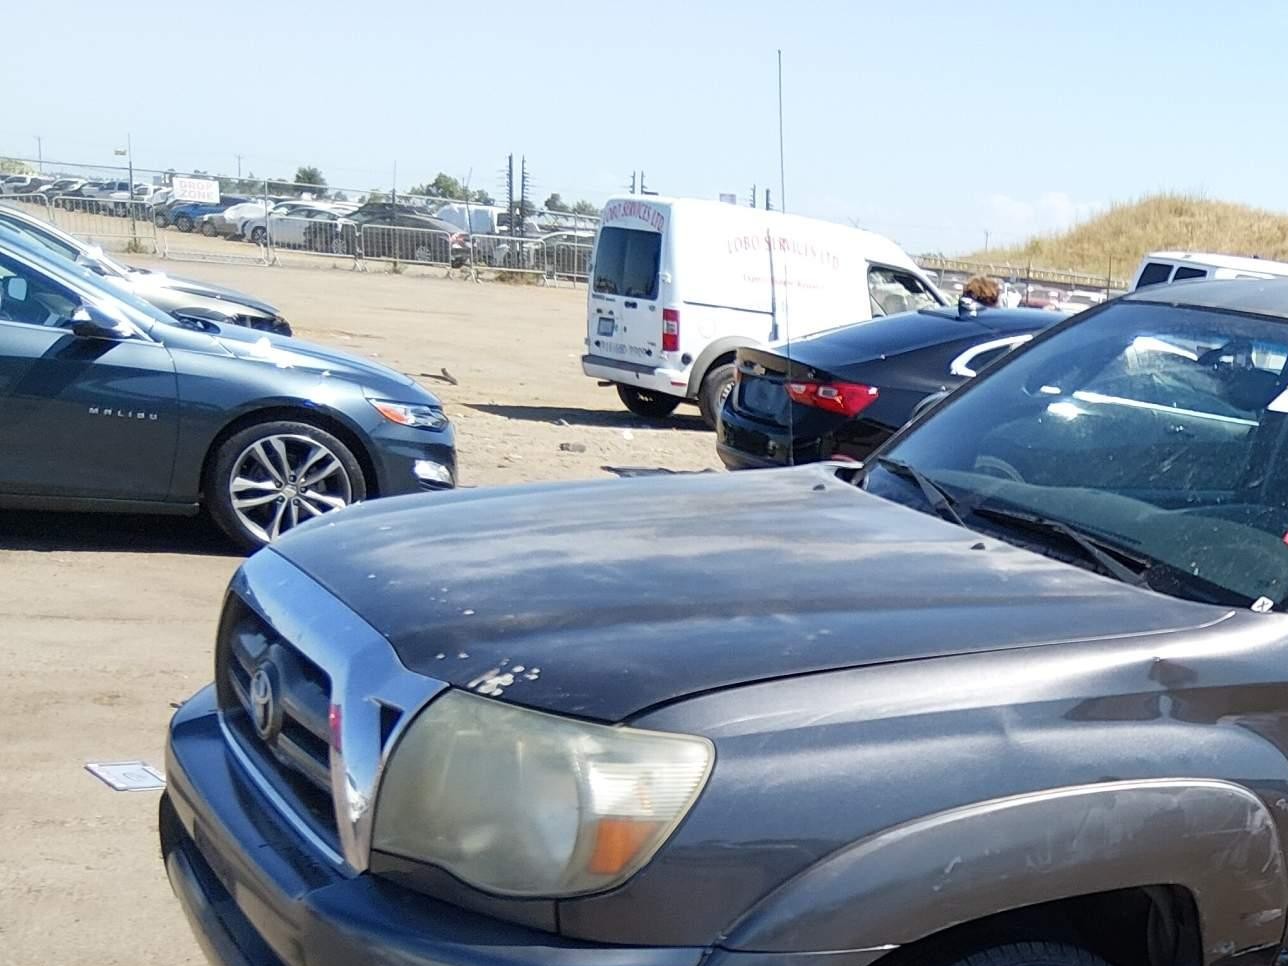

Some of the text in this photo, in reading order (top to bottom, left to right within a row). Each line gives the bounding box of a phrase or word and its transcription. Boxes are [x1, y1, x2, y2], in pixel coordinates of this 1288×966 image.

[179, 181, 213, 191] DROP
[178, 190, 214, 200] ZONE
[727, 235, 760, 254] LOBO
[764, 236, 817, 258] SERVICES
[88, 407, 158, 420] MALIBU
